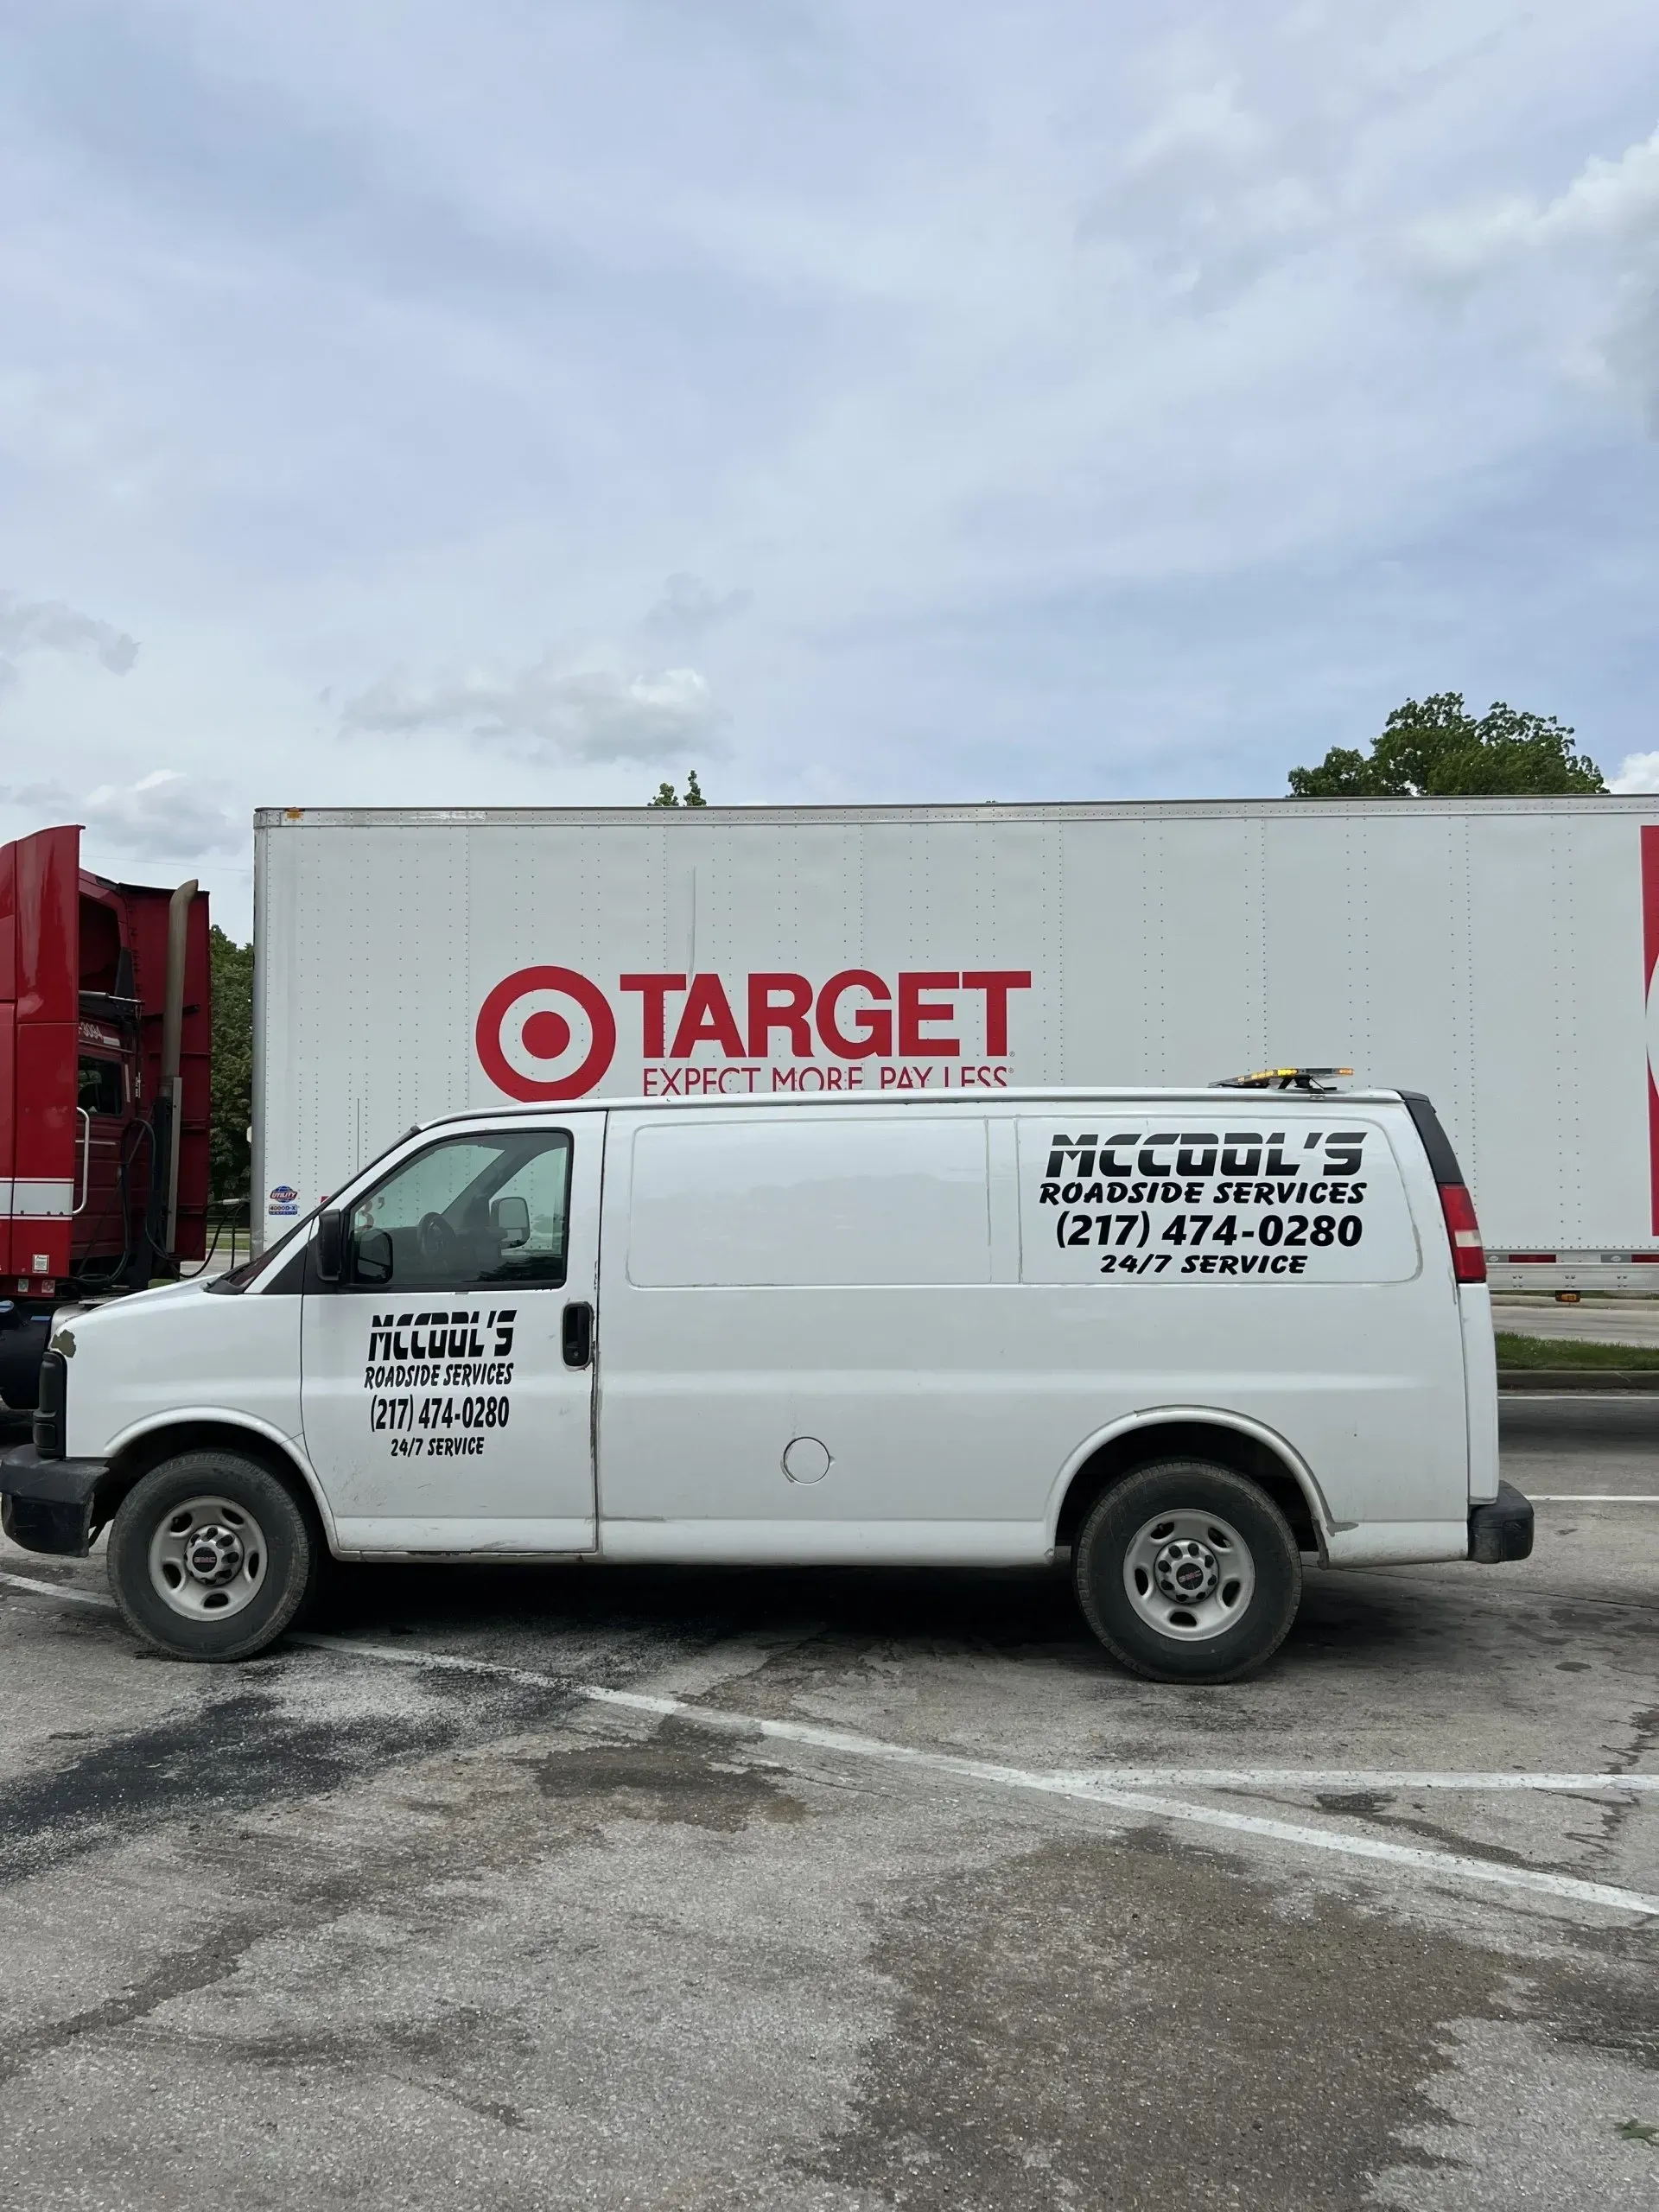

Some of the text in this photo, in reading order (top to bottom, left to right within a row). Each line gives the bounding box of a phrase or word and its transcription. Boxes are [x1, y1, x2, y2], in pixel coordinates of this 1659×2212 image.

[619, 969, 1033, 1060] TARGET
[643, 1067, 761, 1096] EXPECT
[772, 1065, 863, 1091] MORE
[880, 1065, 933, 1089] PAY
[1046, 1132, 1368, 1178] MCCOOL'S
[1039, 1181, 1368, 1206] ROADSIDE SERVICES
[1056, 1211, 1363, 1249] (217) 474-0280
[1100, 1254, 1308, 1275] 24/7 SERVICE
[367, 1309, 518, 1362] MCCOOL'S
[364, 1362, 514, 1390] ROADSIDE SERVICES
[370, 1394, 510, 1433] (217) 474-0280
[390, 1436, 485, 1458] 24/7 SERVICE
